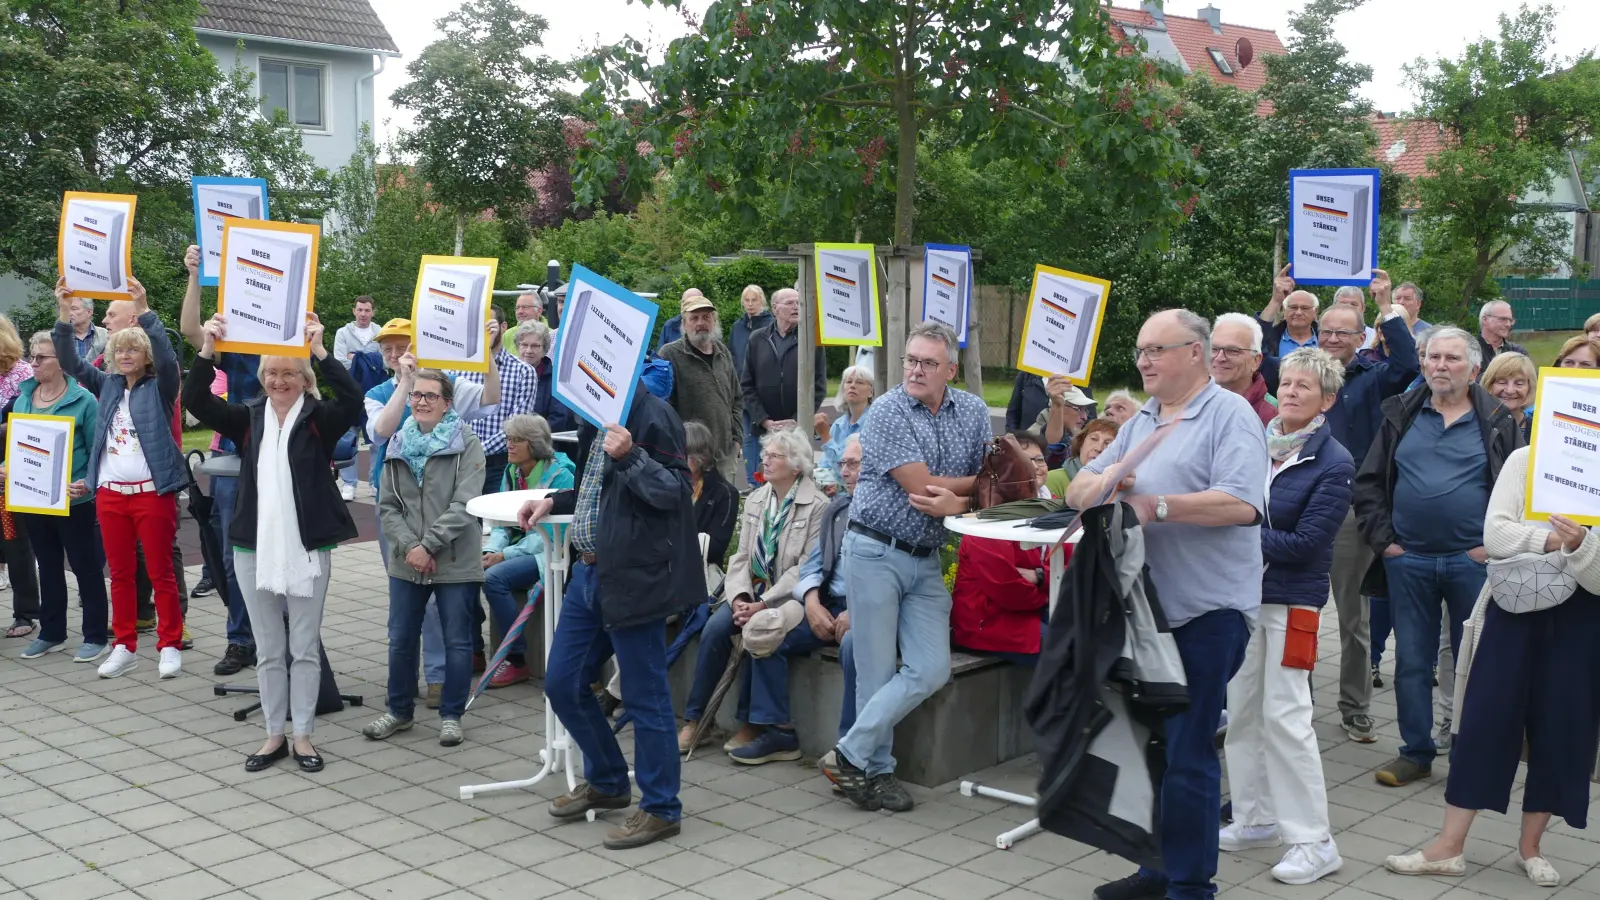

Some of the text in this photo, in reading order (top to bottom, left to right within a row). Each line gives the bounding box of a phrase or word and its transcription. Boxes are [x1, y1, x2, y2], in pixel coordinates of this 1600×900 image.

[1316, 195, 1334, 203] UNSER
[1303, 209, 1348, 224] GRUNDGESETZ
[1313, 221, 1337, 232] STÄRKEN
[252, 249, 270, 260] UNSER
[1309, 252, 1325, 260] WIEDER
[1334, 258, 1348, 266] JETZT!
[236, 264, 283, 283] GRUNDGESETZ
[246, 278, 271, 291] STÄRKEN
[240, 310, 257, 322] WIEDER
[266, 320, 281, 330] JETZT!
[611, 322, 626, 340] WIEDER
[591, 350, 612, 373] STÄRKEN
[586, 383, 601, 401] UNSER
[1572, 401, 1596, 414] UNSER
[1564, 436, 1597, 452] STÄRKEN
[1544, 473, 1554, 481] NIE
[1555, 476, 1577, 488] WIEDER
[1578, 483, 1588, 492] IST
